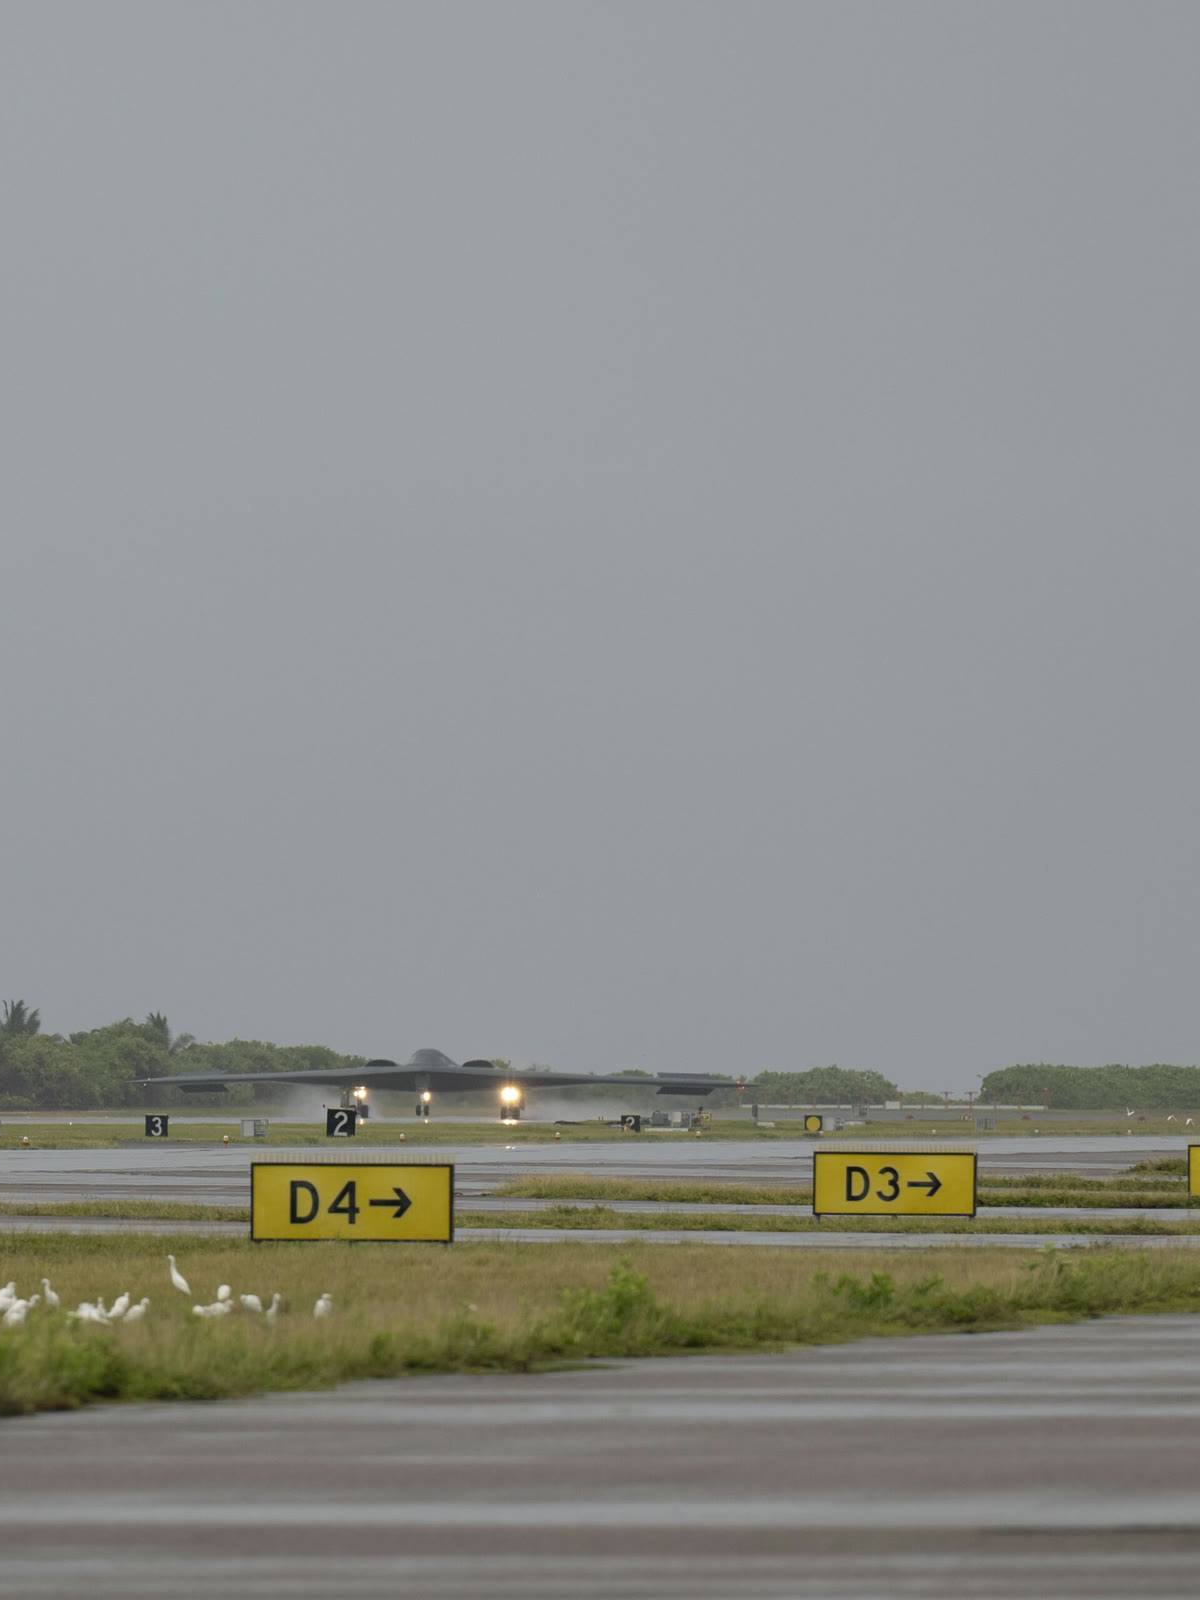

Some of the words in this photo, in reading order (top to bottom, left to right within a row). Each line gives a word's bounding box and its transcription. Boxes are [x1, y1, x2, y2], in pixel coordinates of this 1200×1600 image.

[151, 1117, 162, 1136] 3
[333, 1111, 348, 1136] 2
[846, 1166, 900, 1202] D3
[290, 1180, 360, 1225] D4
